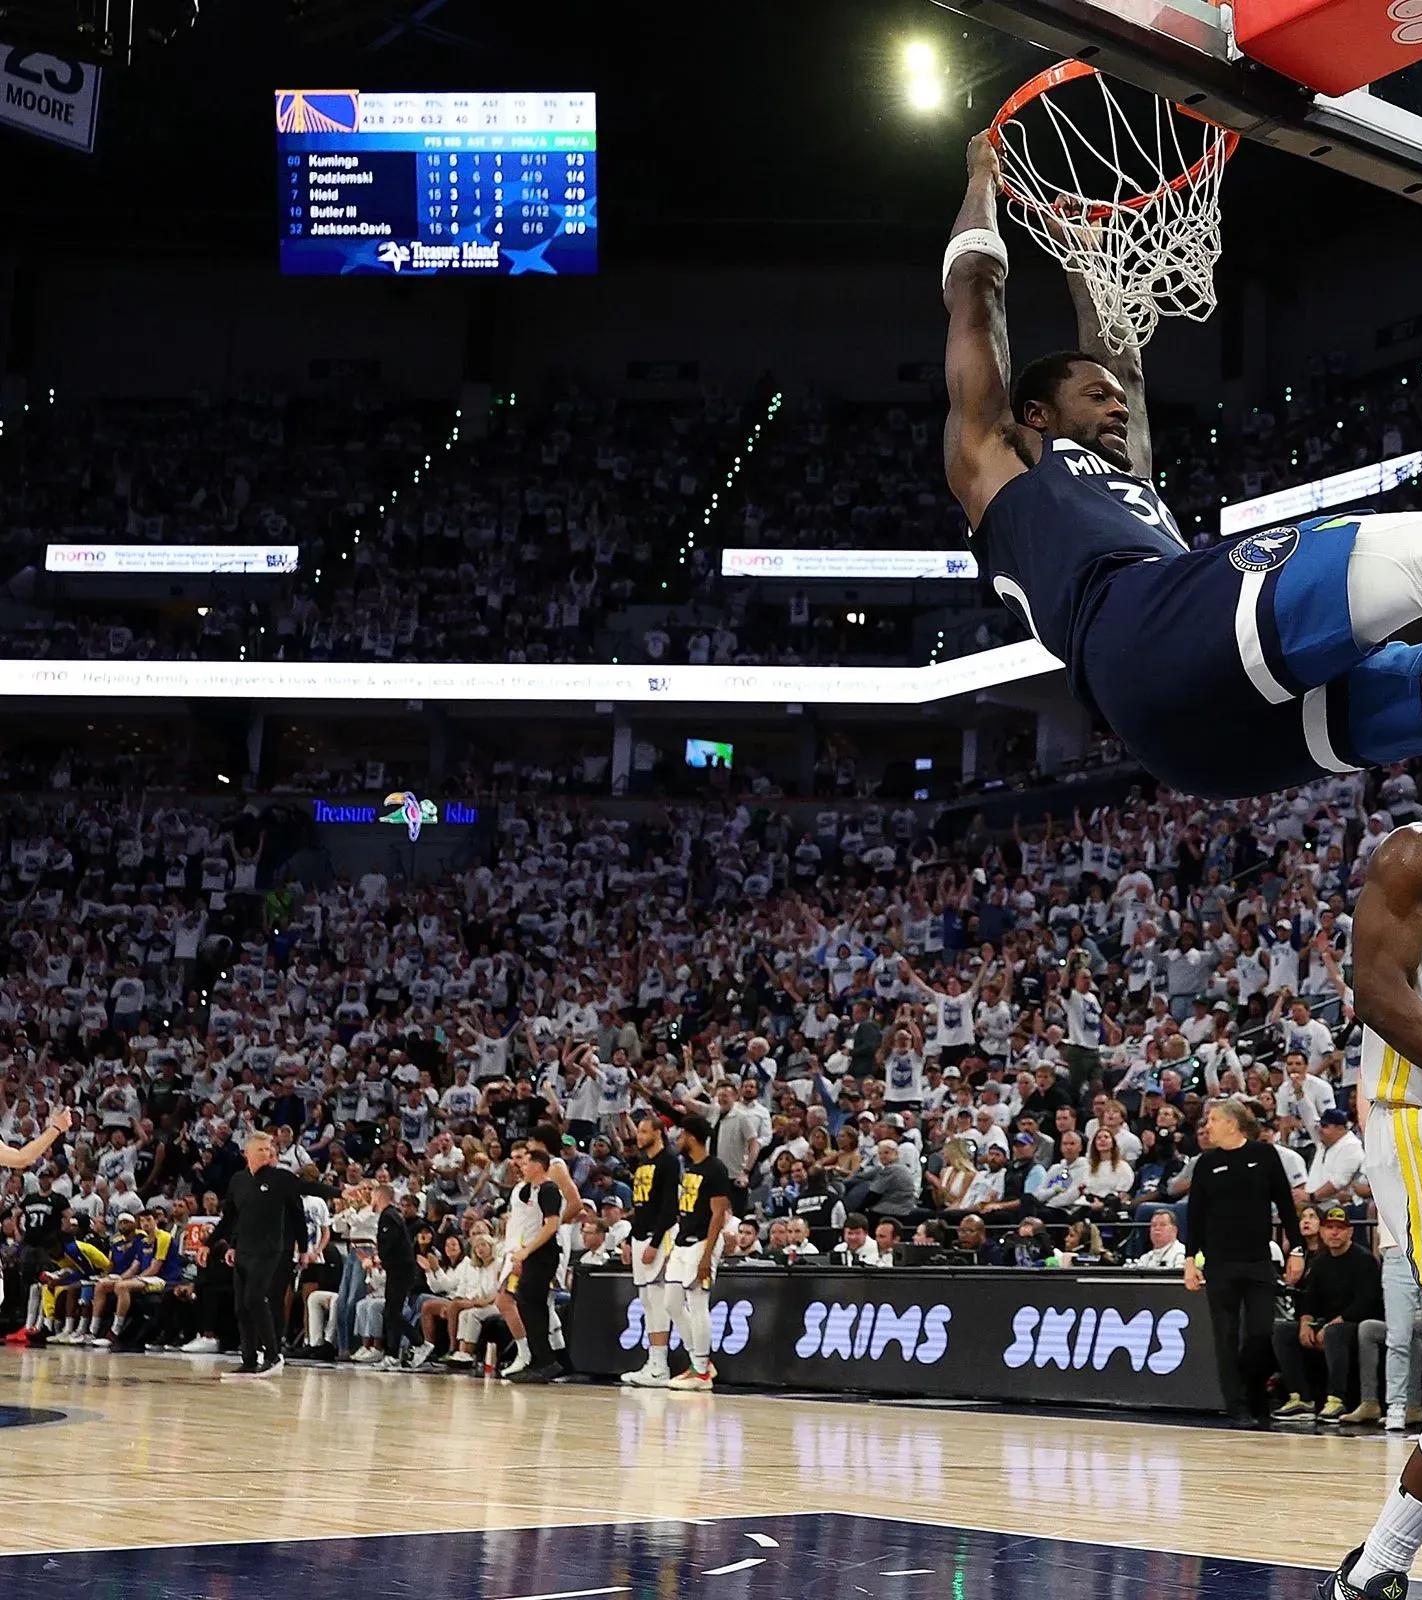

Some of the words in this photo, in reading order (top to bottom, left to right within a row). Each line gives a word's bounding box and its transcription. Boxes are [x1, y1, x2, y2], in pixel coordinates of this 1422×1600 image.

[6, 83, 75, 126] MOORE
[308, 154, 359, 169] Kuminga
[474, 154, 480, 166] 1
[495, 154, 502, 167] 1
[566, 154, 585, 167] 1/3
[309, 171, 373, 184] Podziemski
[428, 171, 440, 184] 11
[521, 171, 543, 184] 4/9
[566, 171, 585, 184] 1/4
[292, 189, 298, 200] 7
[310, 188, 339, 201] Hield
[474, 188, 480, 200] 1
[495, 188, 503, 201] 2
[564, 188, 585, 201] 4/9
[290, 206, 302, 218] 10
[310, 205, 344, 218] Butler
[346, 205, 357, 218] III
[429, 205, 441, 218] 17
[450, 205, 459, 218] 7
[473, 205, 481, 217] 4
[495, 205, 503, 218] 2
[311, 222, 391, 236] Jackson-Davis
[475, 222, 481, 234] 1
[494, 222, 504, 235] 4
[410, 241, 460, 260] Treasure
[462, 241, 500, 260] Island
[54, 551, 107, 562] nomo
[731, 555, 784, 566] nomo
[83, 672, 141, 687] Helping
[313, 799, 376, 823] Treasure
[30, 1212, 45, 1228] 21
[795, 1300, 951, 1365] SKIMS
[1003, 1305, 1190, 1375] SKIMS
